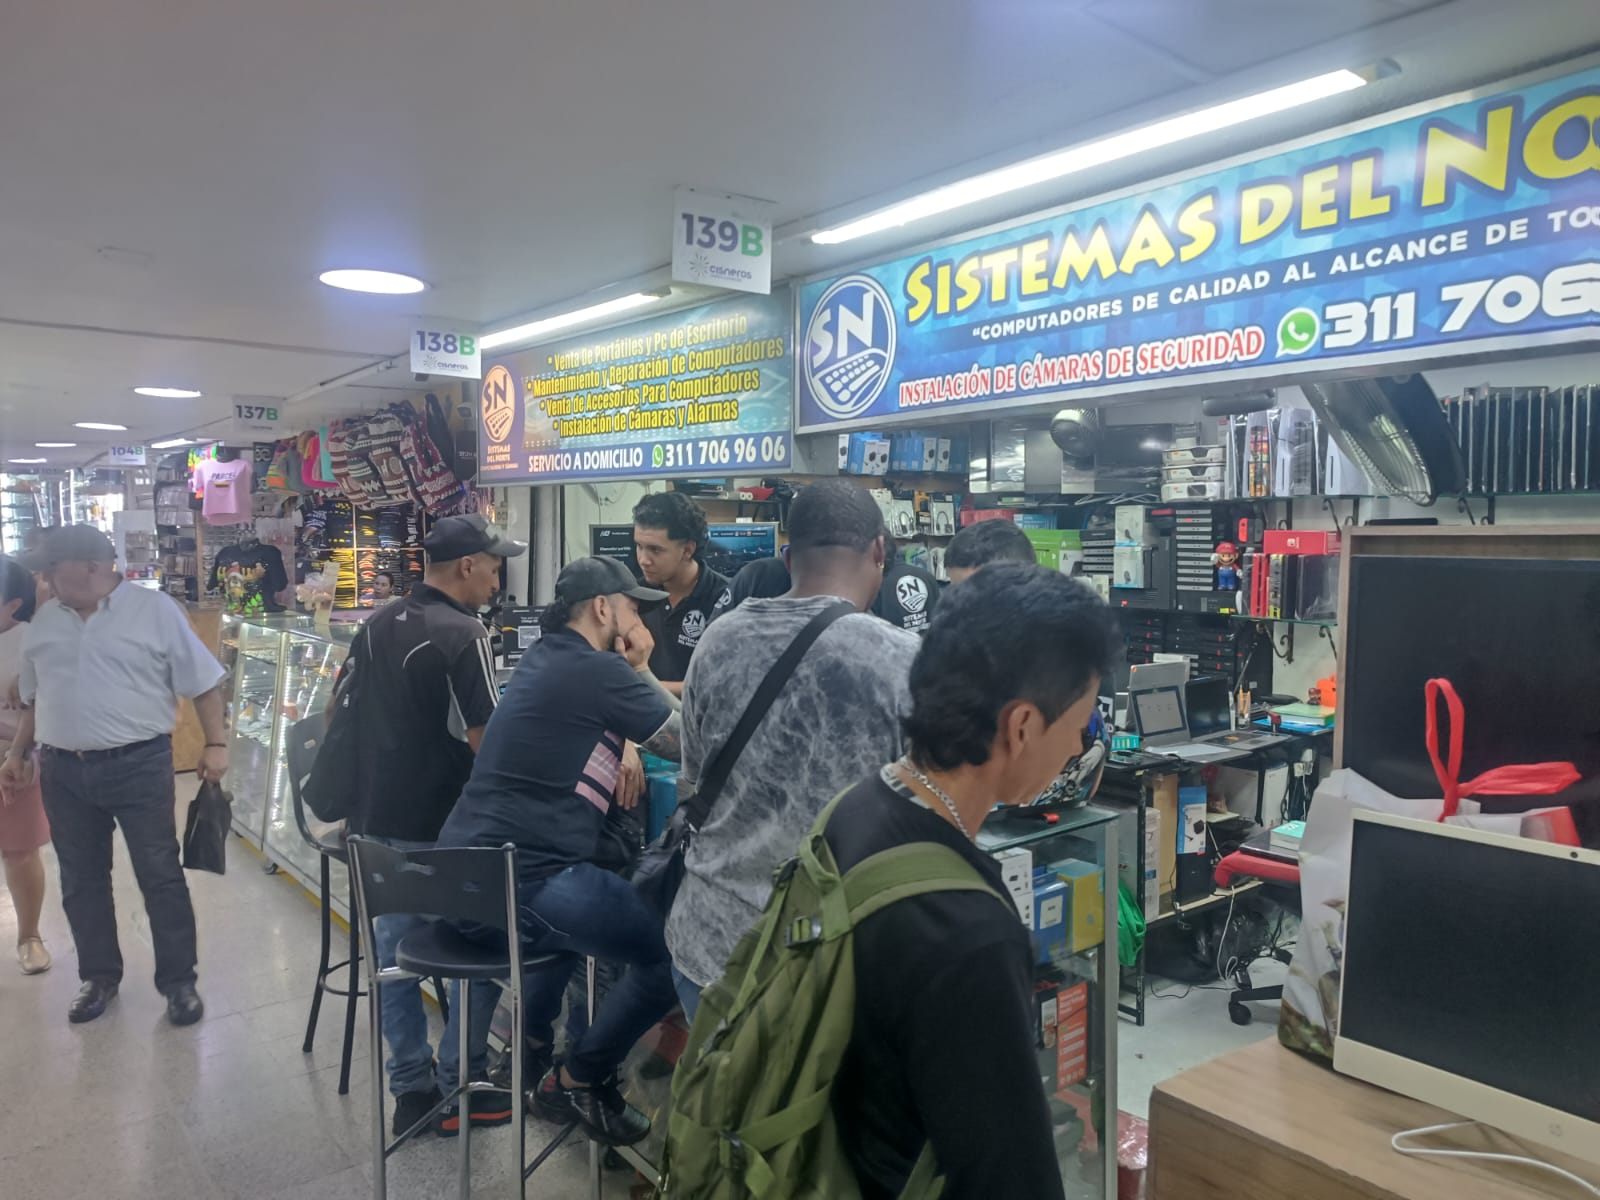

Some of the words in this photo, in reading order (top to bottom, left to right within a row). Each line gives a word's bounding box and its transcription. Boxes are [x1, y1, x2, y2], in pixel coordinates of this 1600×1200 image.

[681, 212, 763, 257] 139B
[906, 193, 1217, 322] SISTEMAS
[1239, 157, 1391, 245] DEL
[1132, 292, 1159, 312] DE
[1169, 271, 1270, 305] CALIDAD
[1283, 263, 1316, 284] AL
[1330, 230, 1468, 274] ALCANCE
[1486, 218, 1529, 245] DE
[1324, 291, 1416, 349] 311
[1440, 262, 1600, 332] 706
[416, 331, 475, 355] 138B
[554, 351, 579, 372] Venta
[595, 338, 644, 362] Portátiles
[646, 336, 652, 356] y
[654, 332, 667, 352] Pc
[670, 329, 684, 349] de
[687, 313, 747, 346] Escritorio
[811, 290, 874, 369] SN
[533, 369, 600, 397] Mantenimiento
[602, 370, 608, 389] y
[609, 356, 669, 385] Reparación
[671, 354, 686, 375] de
[688, 337, 784, 371] Computadores
[900, 364, 990, 406] INSTALACIÓN
[994, 366, 1016, 392] DE
[1020, 354, 1101, 386] CÁMARAS
[1106, 346, 1133, 377] DE
[1137, 326, 1265, 373] SEGURIDAD
[235, 405, 278, 420] 137B
[484, 373, 507, 415] SN
[546, 396, 571, 416] Venta
[573, 394, 584, 413] de
[586, 387, 639, 411] Accesorios
[642, 384, 667, 404] Para
[669, 370, 760, 400] Computadores
[560, 413, 612, 438] Instalación
[614, 413, 626, 432] de
[628, 408, 676, 429] Cámaras
[678, 407, 685, 428] y
[687, 400, 738, 424] Alarmas
[528, 452, 571, 472] SERVICIO
[573, 451, 581, 470] A
[583, 447, 643, 470] DOMICILIO
[665, 442, 693, 467] 311
[698, 439, 730, 465] 706
[734, 437, 757, 463] 96
[761, 435, 786, 462] 06
[898, 578, 920, 600] SN
[684, 613, 702, 625] SN
